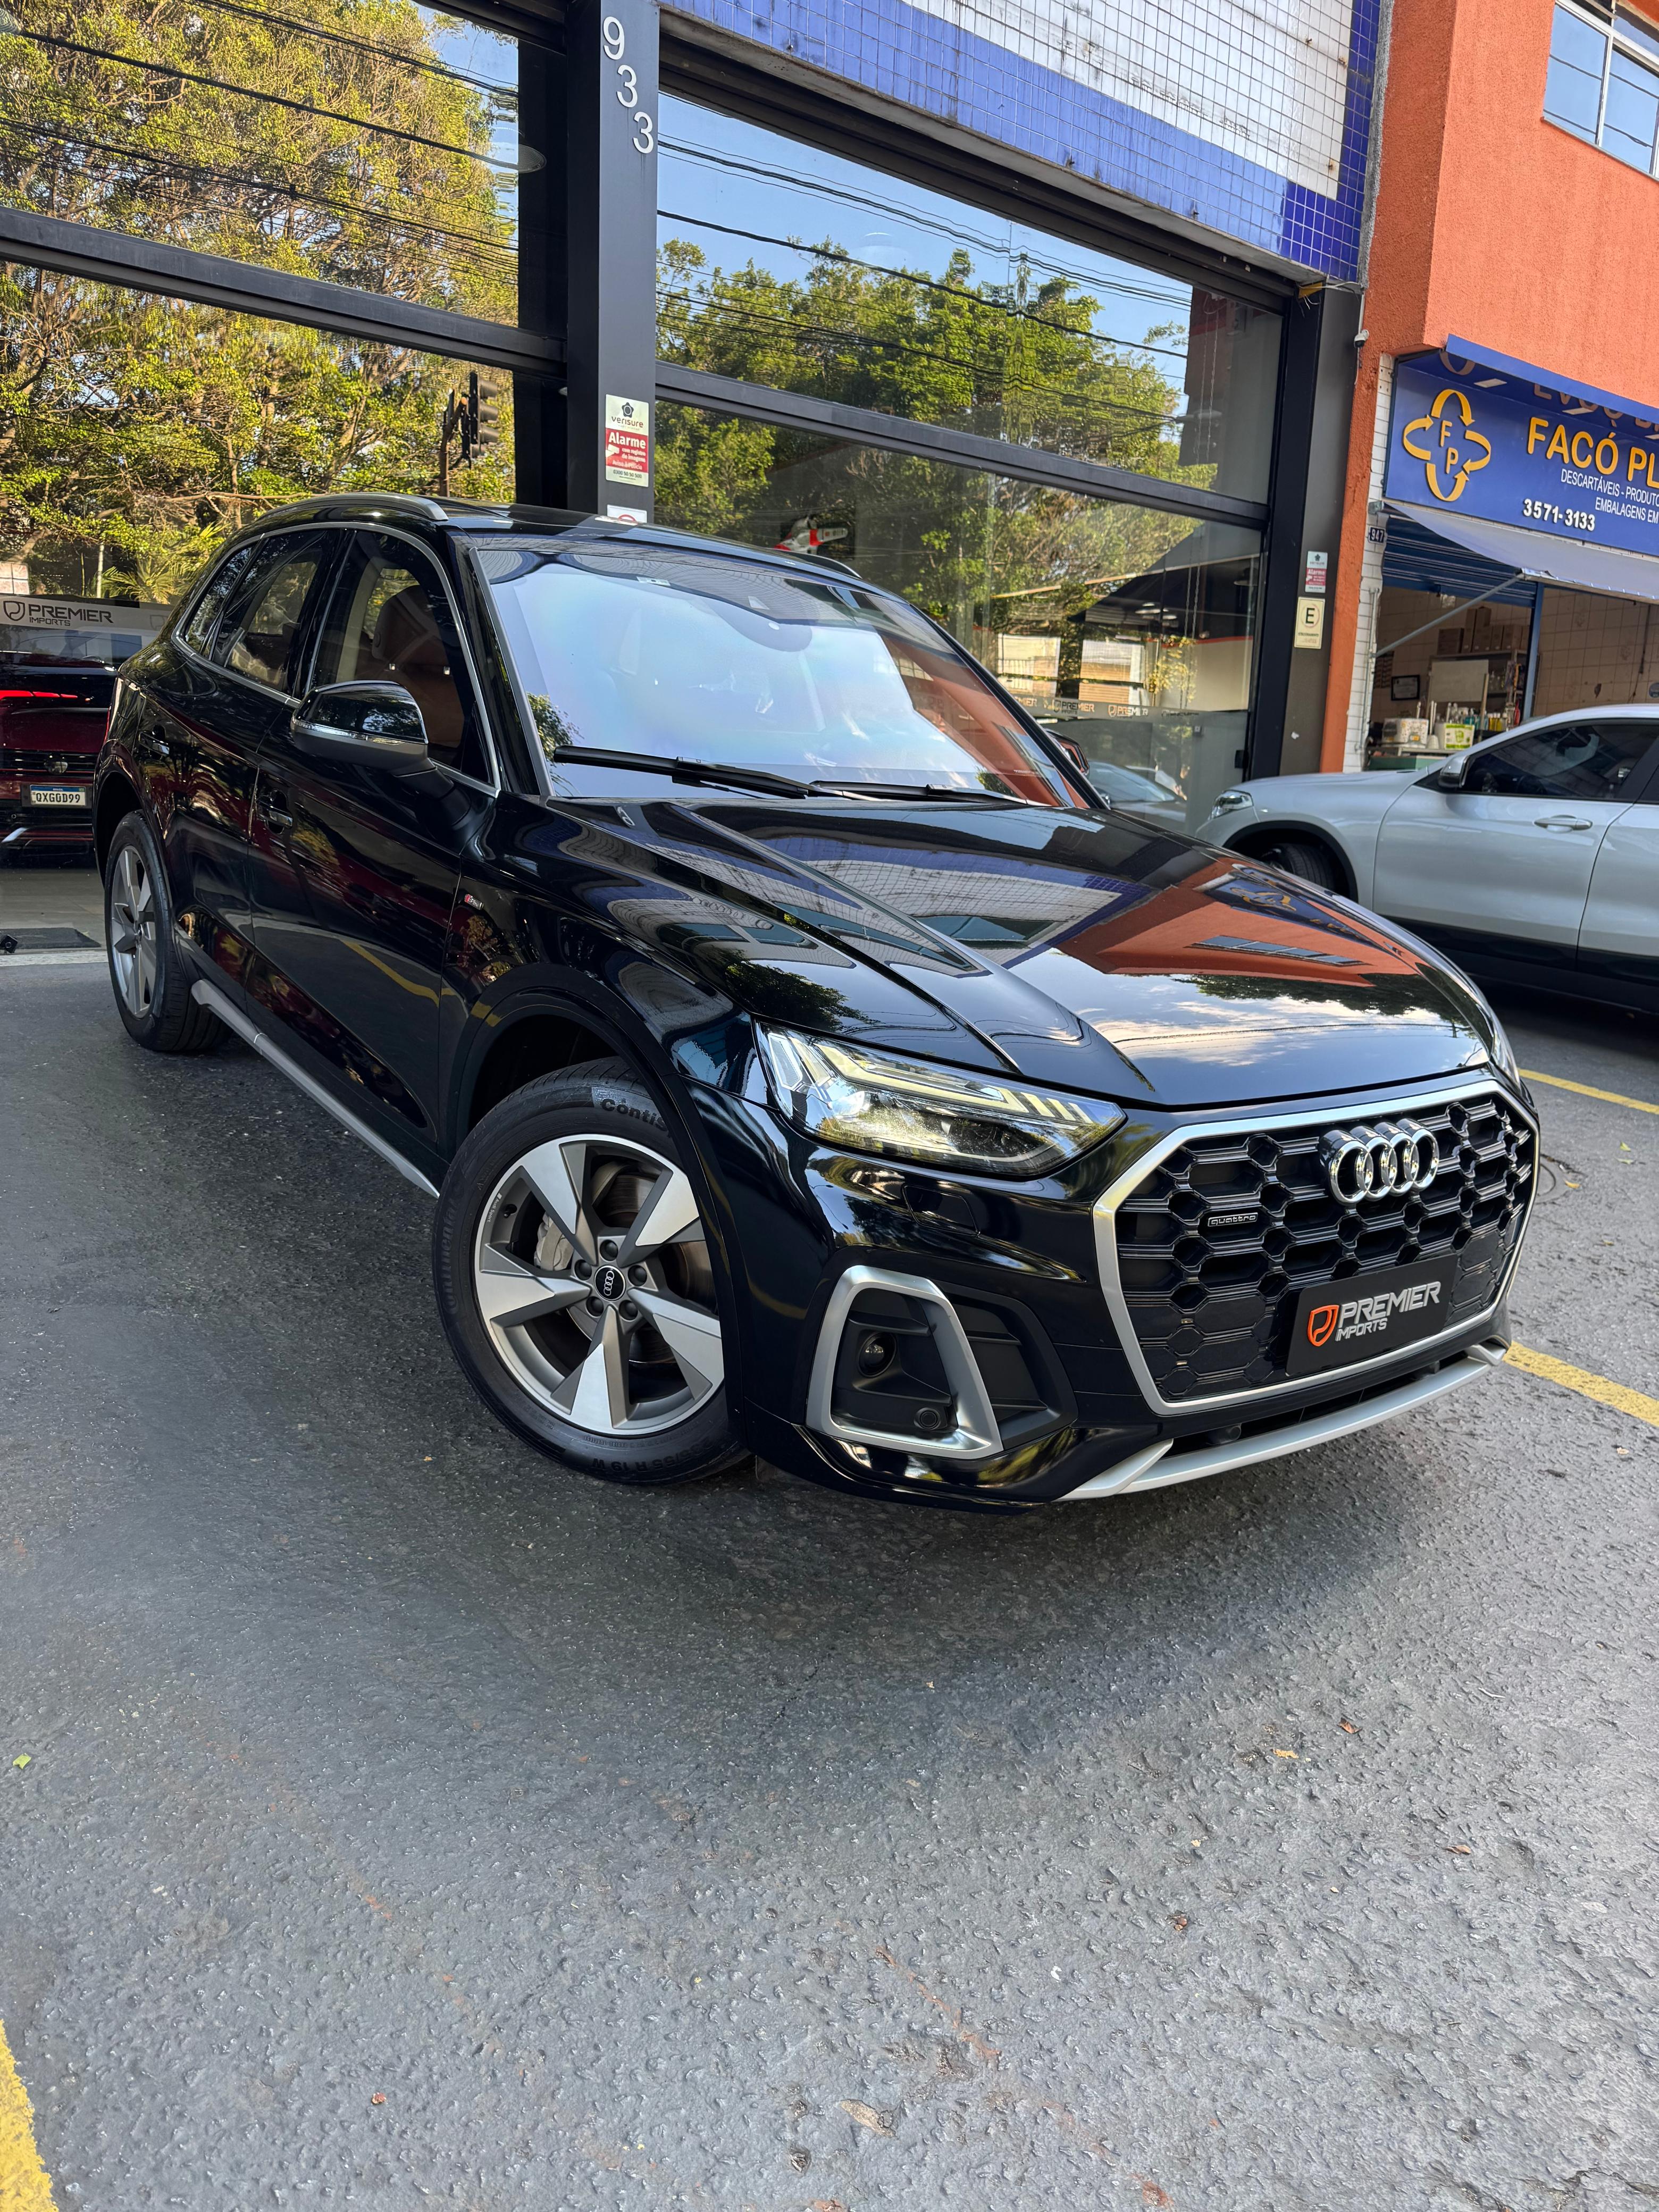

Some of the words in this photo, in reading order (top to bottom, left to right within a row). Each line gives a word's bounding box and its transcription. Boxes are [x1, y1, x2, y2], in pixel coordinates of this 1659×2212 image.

[603, 16, 654, 154] 933
[611, 416, 644, 428] verisure
[1440, 420, 1453, 447] F
[608, 431, 647, 450] Alarme
[1446, 447, 1459, 474] P
[1527, 417, 1619, 475] FACÓ
[1627, 447, 1659, 489] PL
[1561, 468, 1620, 497] DESCARTÁVEIS
[1523, 498, 1596, 532] 3571-3133
[1595, 497, 1646, 521] EMBALAGENS
[1371, 529, 1384, 542] 947
[28, 604, 114, 624] PREMIER
[29, 616, 71, 626] IMPORTS
[1305, 607, 1315, 624] E
[601, 1099, 671, 1138] ContiS
[1211, 1215, 1256, 1226] quattro
[1337, 1281, 1442, 1328] PREMIER
[1335, 1318, 1388, 1342] IMPORTS
